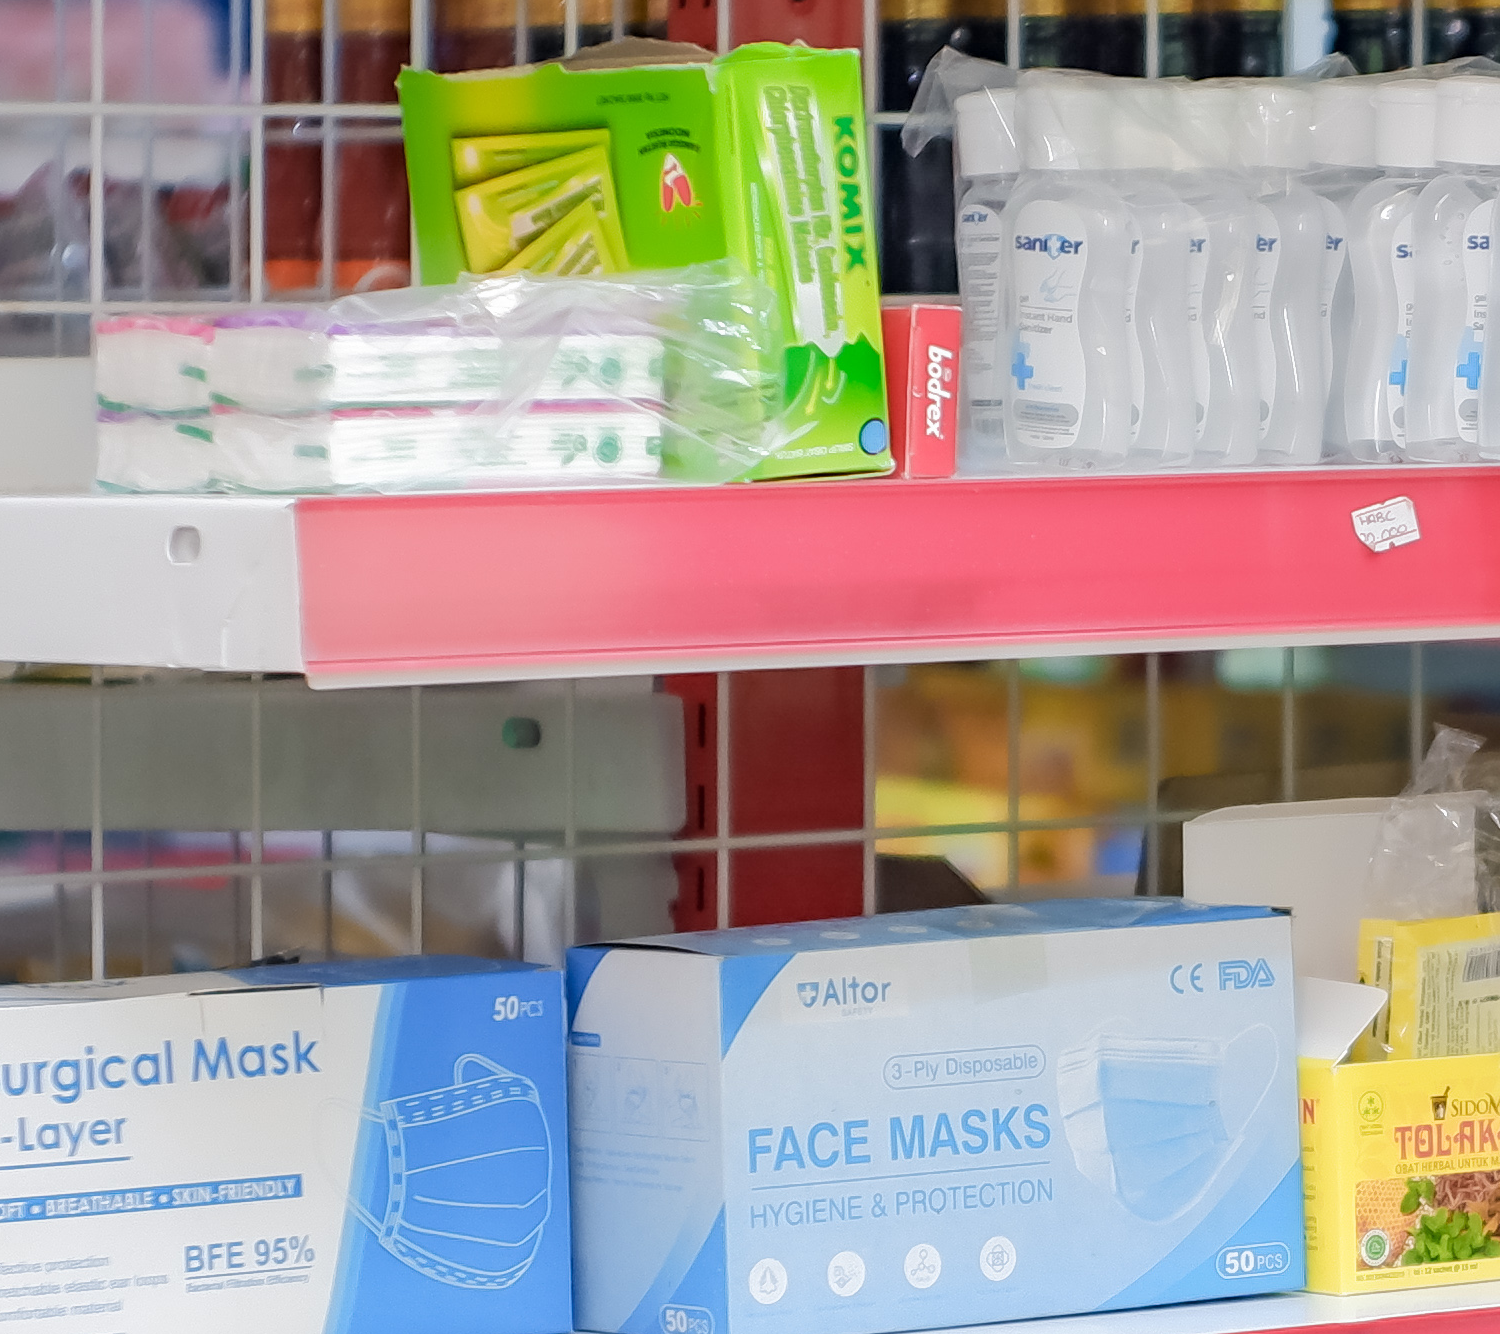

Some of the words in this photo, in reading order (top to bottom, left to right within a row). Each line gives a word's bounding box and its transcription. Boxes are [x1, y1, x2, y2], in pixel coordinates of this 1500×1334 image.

[834, 115, 867, 272] KOMIX
[925, 344, 952, 439] bodrex
[822, 977, 891, 1006] Altor
[1218, 958, 1275, 991] FDA
[191, 1029, 322, 1082] Mask
[891, 1058, 939, 1082] 3-Ply
[946, 1052, 1038, 1077] Disposable
[749, 1119, 871, 1173] FACE
[890, 1103, 1051, 1161] MASKS
[1395, 1160, 1420, 1175] OBAT
[1421, 1158, 1456, 1172] HERBAL
[1457, 1155, 1489, 1170] UNTUK
[45, 1191, 155, 1217] BREATHABLE
[170, 1178, 298, 1207] SKIN-FRIENDLY
[751, 1196, 863, 1228] HYGIENE
[871, 1193, 888, 1218] &
[896, 1178, 1053, 1216] PROTECTION
[184, 1240, 245, 1273] BFE
[254, 1234, 316, 1267] 95%
